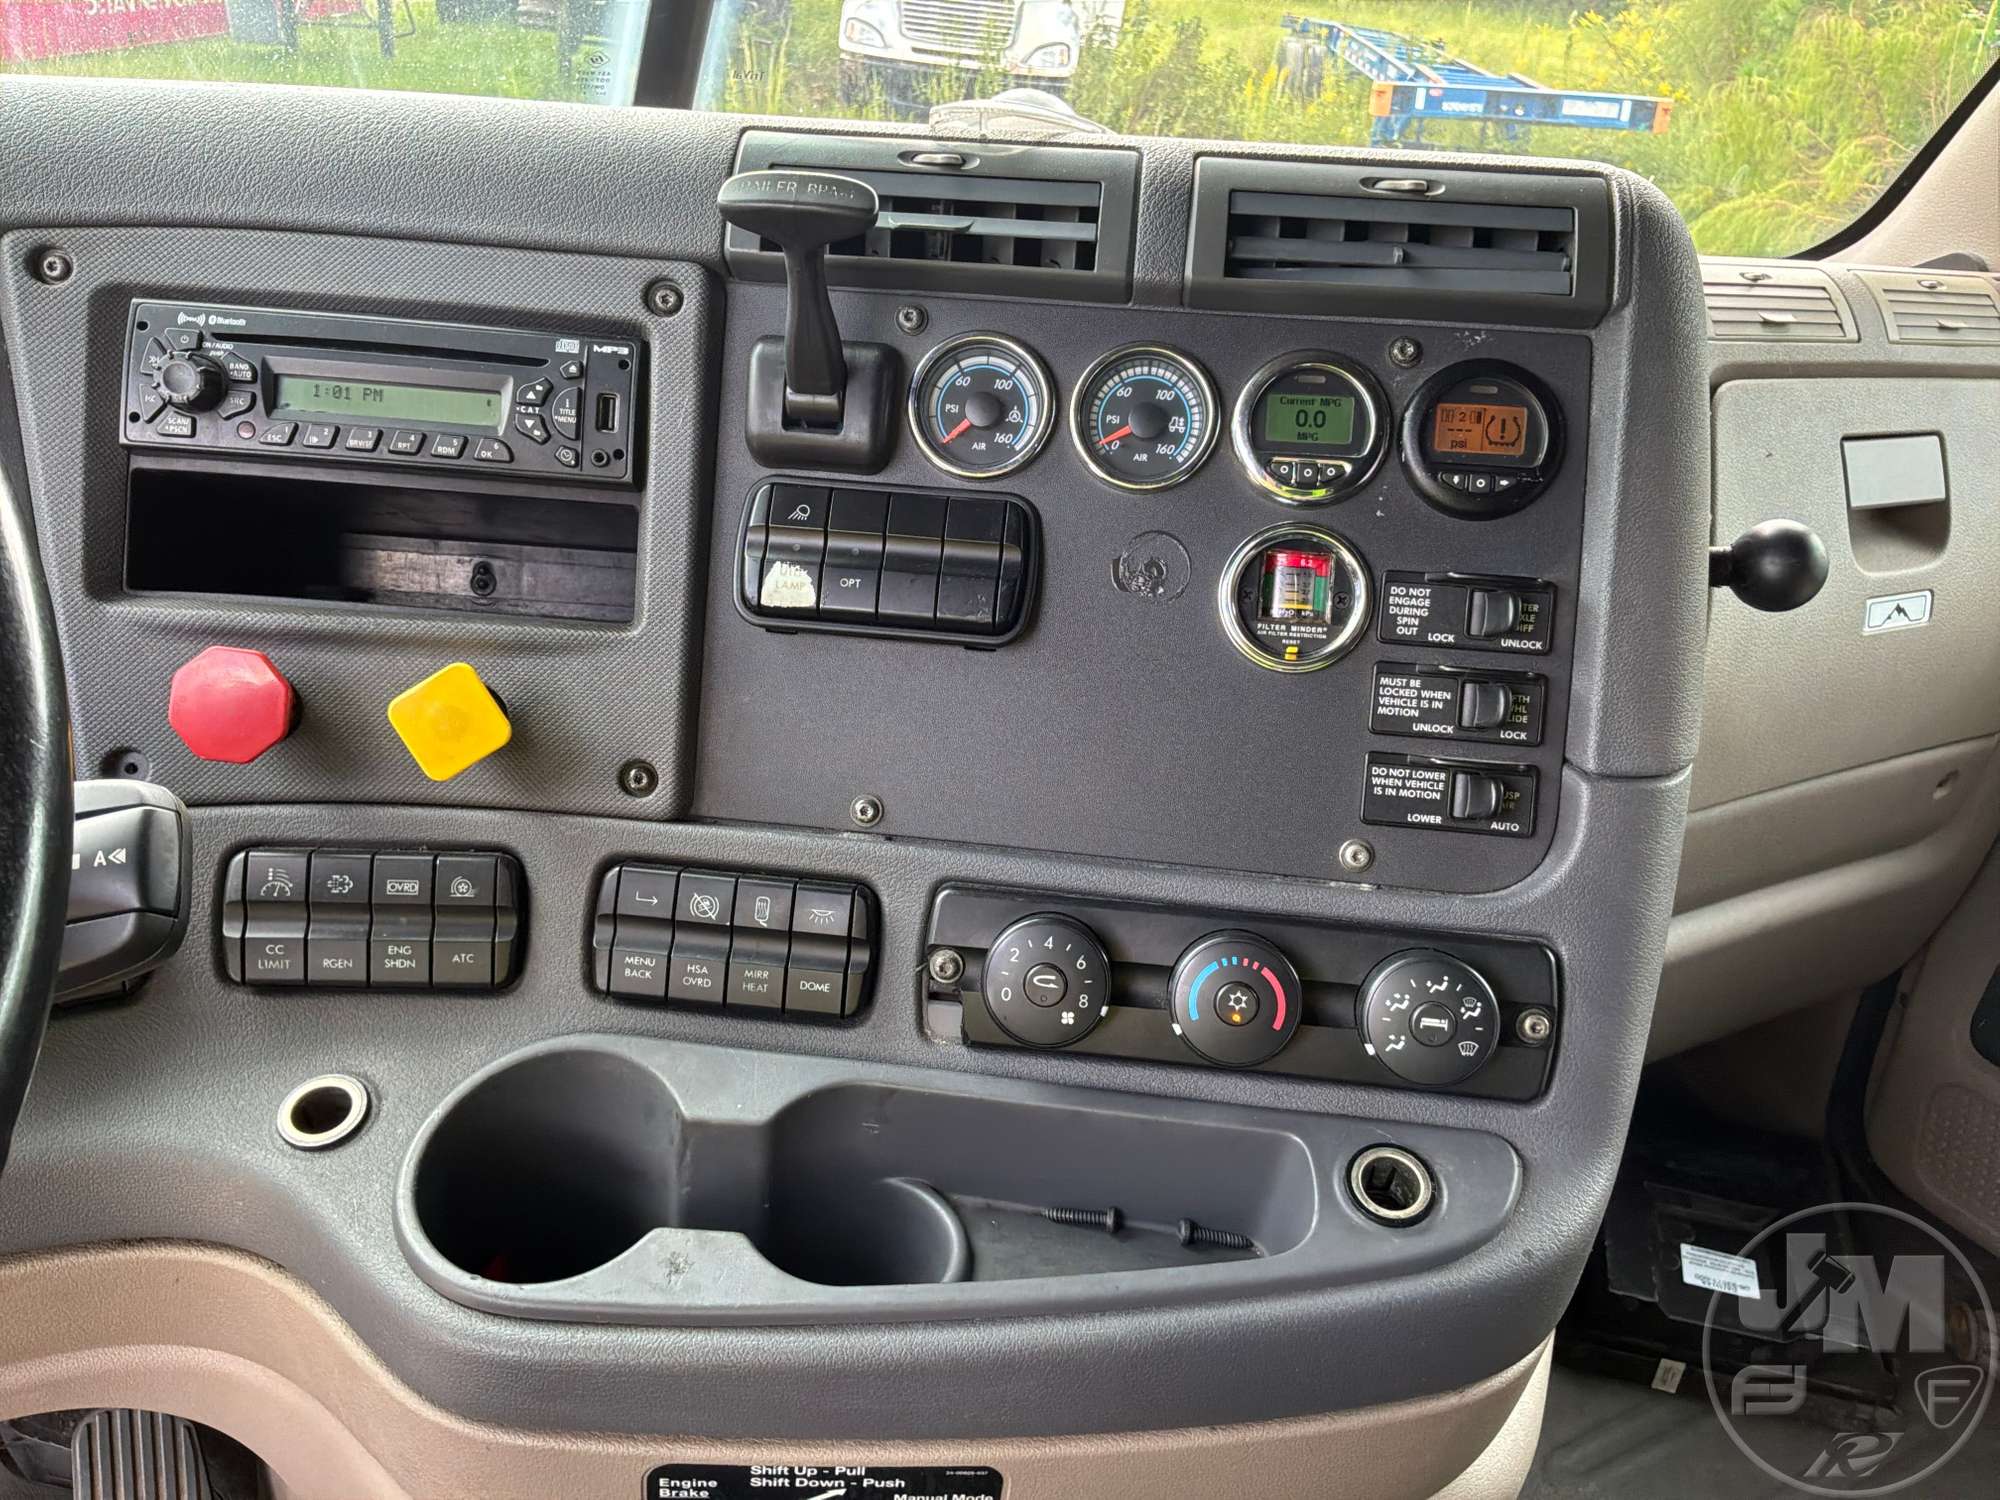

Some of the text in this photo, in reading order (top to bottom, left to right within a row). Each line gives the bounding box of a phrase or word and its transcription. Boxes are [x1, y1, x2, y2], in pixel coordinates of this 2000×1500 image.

[593, 344, 630, 355] MP3
[955, 376, 971, 386] 60
[994, 379, 1013, 390] 100
[312, 384, 385, 402] 1:01 PM
[1116, 387, 1132, 397] 60
[1155, 389, 1175, 400] 100
[1279, 396, 1342, 408] Current MPG
[559, 408, 576, 416] TITLE
[945, 404, 959, 413] PSI
[1106, 415, 1120, 424] PSI
[1295, 409, 1327, 429] 0.0
[1458, 412, 1466, 422] 2
[994, 433, 1013, 444] 160
[1296, 431, 1319, 442] MPG
[971, 442, 986, 451] AIR
[1111, 440, 1120, 450] 0
[1155, 444, 1176, 455] 160
[1450, 439, 1467, 449] psi
[437, 446, 456, 454] RDM
[1133, 453, 1148, 462] AIR
[839, 578, 862, 589] OPT
[1390, 587, 1431, 597] DO NOT
[1388, 596, 1431, 607] ENGAGE
[1389, 606, 1429, 617] DURING
[1396, 616, 1419, 626] SPIN
[1519, 614, 1536, 623] XLE
[1256, 623, 1286, 631] FILTER
[1396, 626, 1418, 636] OUT
[1517, 624, 1535, 633] IFF
[1427, 633, 1455, 643] LOCK
[1501, 638, 1543, 650] UNLOCK
[1379, 677, 1421, 687] MUST BE
[1379, 687, 1451, 700] LOCKED WHEN
[1378, 696, 1443, 709] VEHICLE IS IN
[1377, 706, 1419, 717] MOTION
[1412, 723, 1455, 734] UNLOCK
[1500, 730, 1527, 740] LOCK
[1371, 766, 1446, 780] DO NOT LOWER
[1371, 776, 1445, 791] WHEN VEHICLE
[1373, 786, 1441, 800] IS IN MOTION
[1407, 813, 1442, 825] LOWER
[1490, 821, 1519, 832] AUTO
[388, 882, 418, 893] OVRD
[1044, 936, 1054, 949] 4
[265, 944, 285, 955] CC
[388, 945, 412, 956] ENG
[1009, 948, 1020, 962] 2
[322, 959, 353, 969] RGEN
[384, 958, 416, 969] SHDN
[452, 953, 475, 964] ATC
[624, 956, 656, 968] MENU
[1076, 955, 1086, 969] 6
[258, 959, 290, 970] LIMIT
[687, 963, 709, 975] HSA
[624, 967, 651, 979] BACK
[744, 969, 769, 980] MIRR
[682, 976, 712, 988] OVRD
[742, 982, 769, 993] HEAT
[799, 981, 831, 993] DOME
[1000, 988, 1011, 1001] 0
[1078, 994, 1089, 1008] 8
[750, 1465, 790, 1476] Shift
[794, 1466, 818, 1478] Up
[834, 1466, 866, 1476] Pull
[658, 1478, 718, 1489] Engine
[750, 1477, 790, 1488] Shift
[795, 1477, 845, 1488] Down
[862, 1478, 906, 1488] Push
[658, 1488, 710, 1498] Brake
